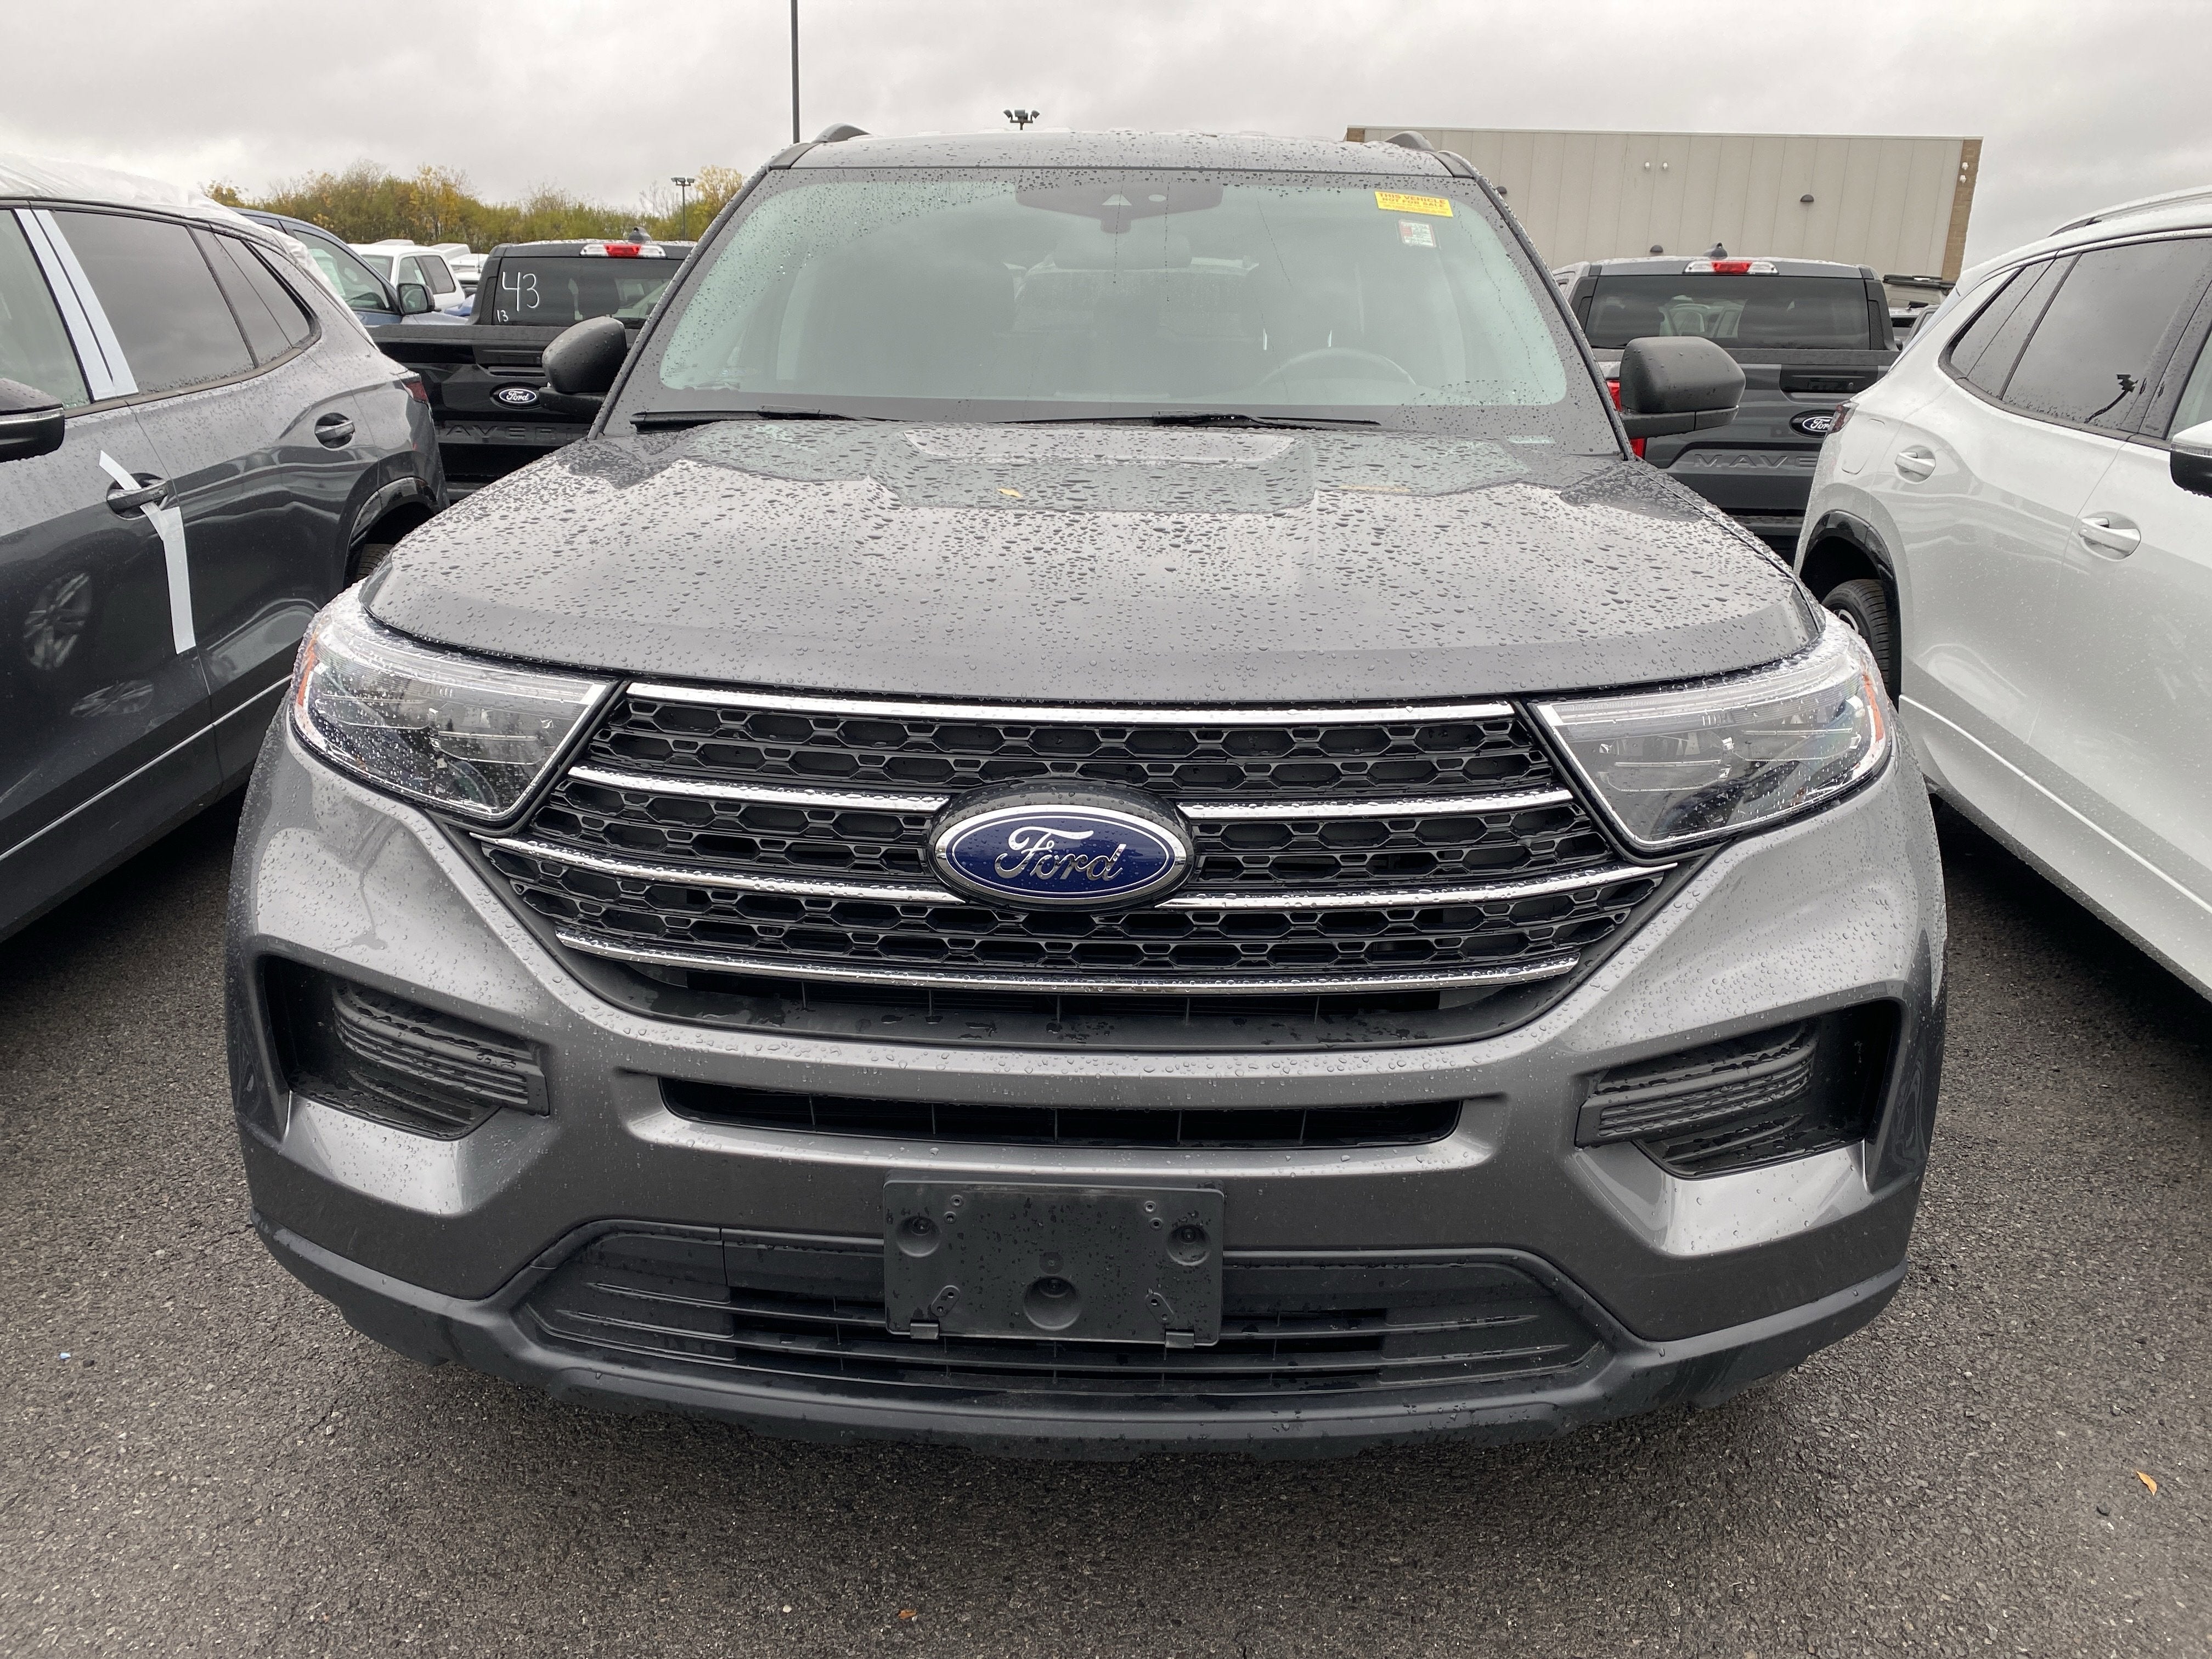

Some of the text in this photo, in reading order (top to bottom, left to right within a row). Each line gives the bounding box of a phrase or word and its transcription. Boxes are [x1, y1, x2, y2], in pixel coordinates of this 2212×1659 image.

[1403, 195, 1446, 205] VEHICLE
[501, 271, 539, 312] 43
[496, 309, 509, 323] 13
[506, 390, 529, 401] Ford
[1810, 418, 1831, 430] For
[994, 826, 1127, 882] Ford
